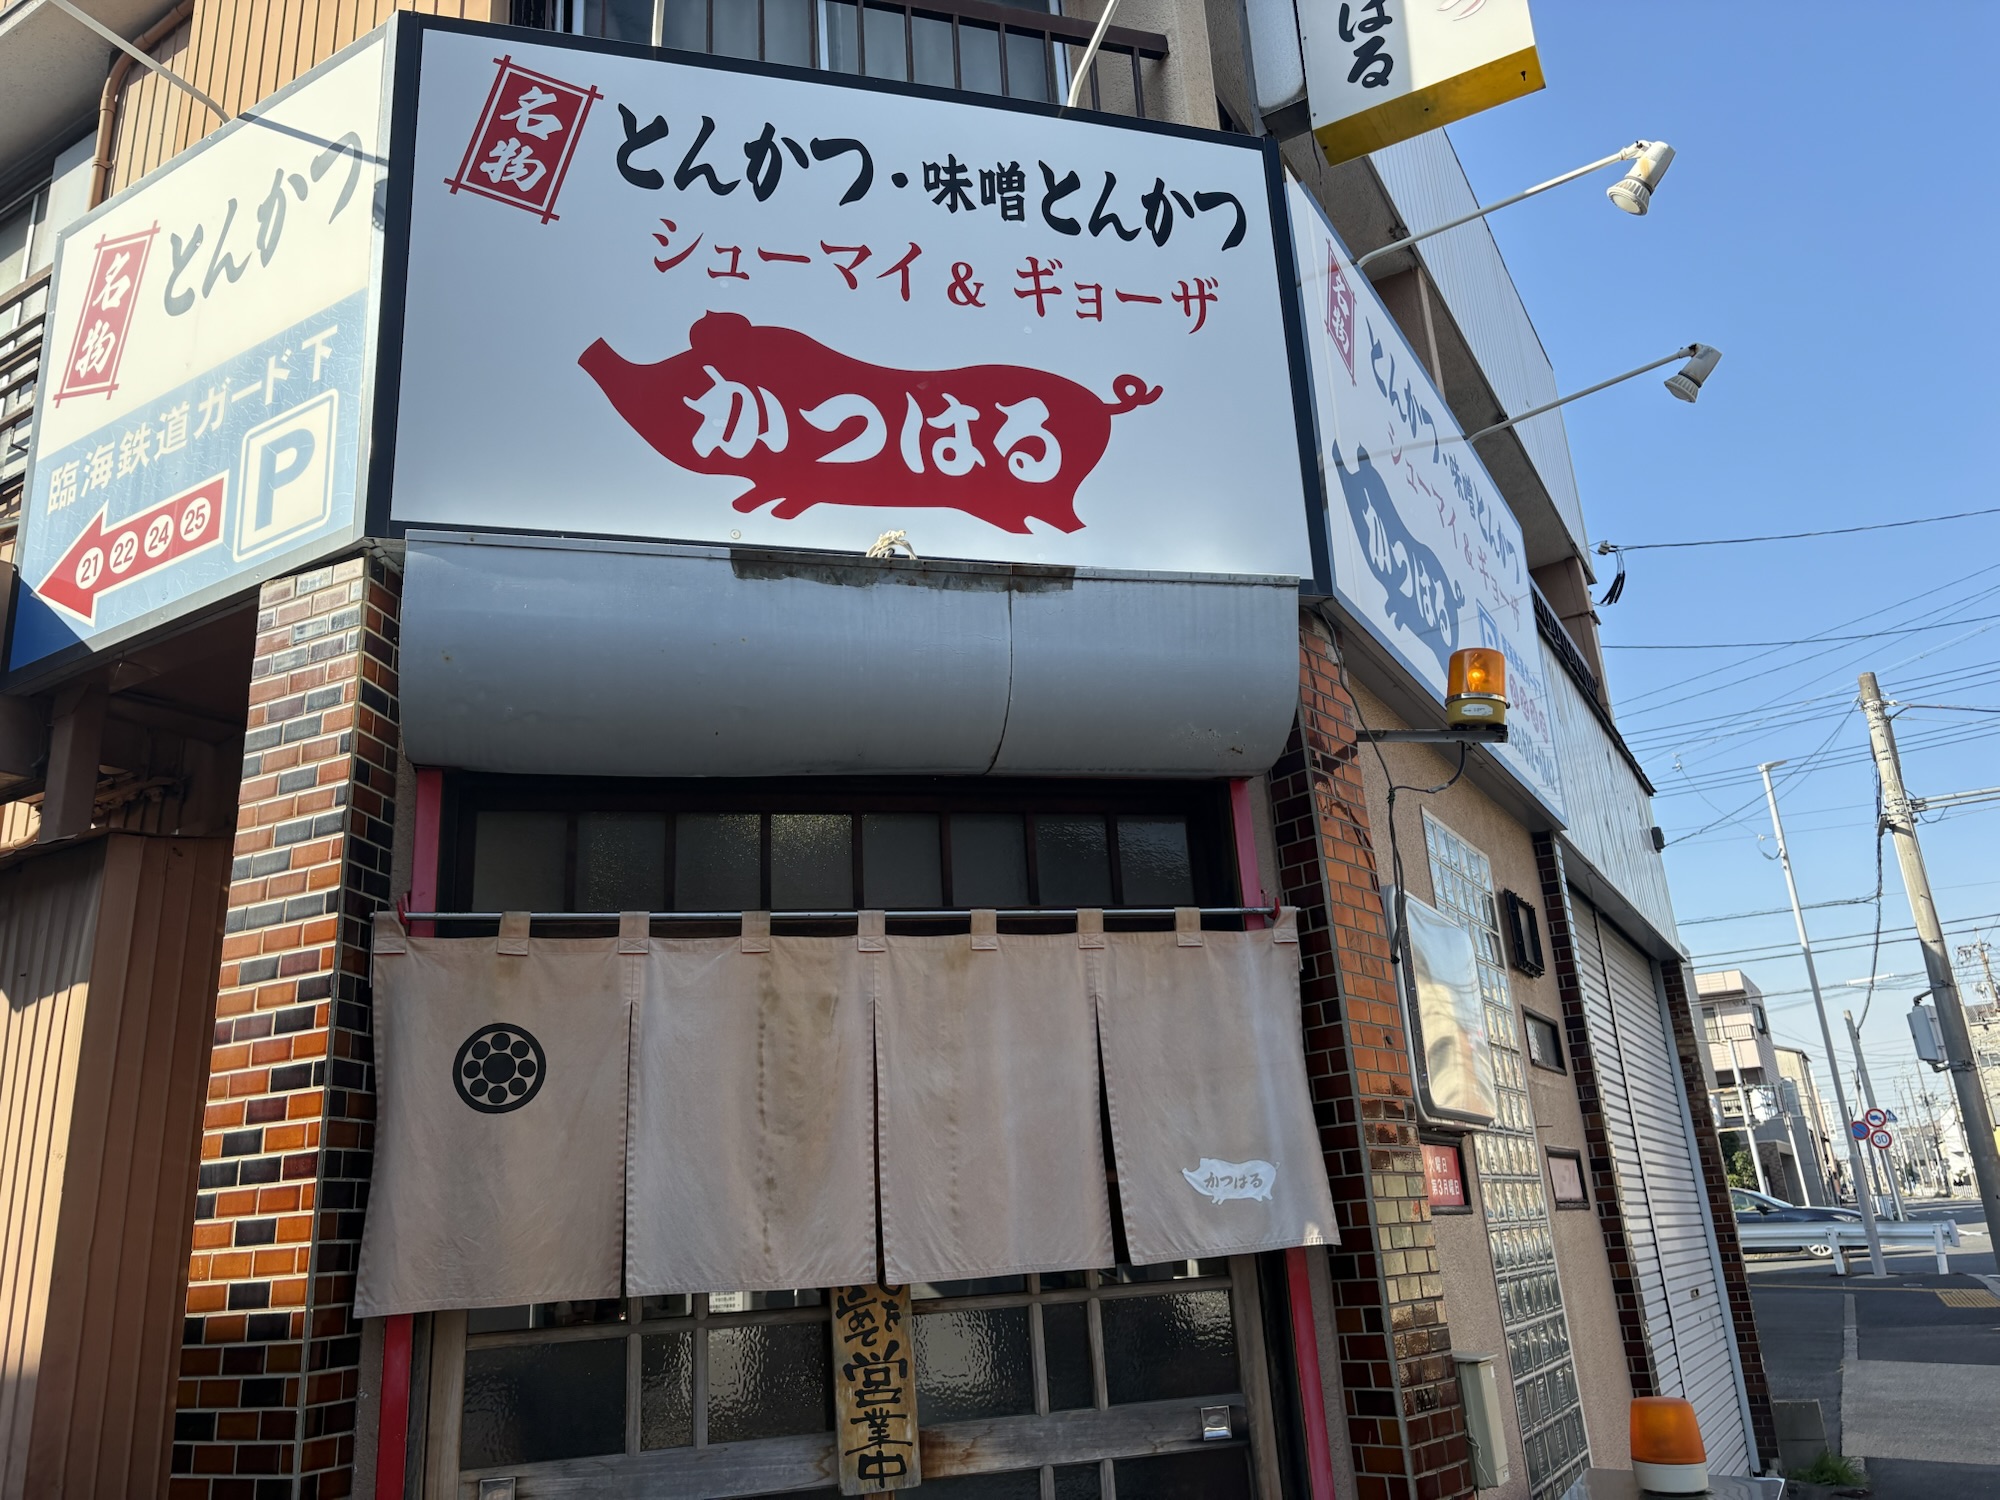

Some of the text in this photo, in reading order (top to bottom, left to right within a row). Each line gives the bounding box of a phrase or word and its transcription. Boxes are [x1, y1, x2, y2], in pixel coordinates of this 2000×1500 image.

[1338, 0, 1394, 88] はる
[478, 84, 566, 193] 名物
[615, 102, 1249, 251] とんかつ・味噌とんかつ
[163, 131, 364, 317] とんかつ
[651, 217, 1220, 334] シューマイ & ギョーザ
[74, 250, 133, 380] 名物
[1331, 273, 1351, 355] 名物
[46, 324, 340, 516] 臨海鉄道ガード下
[683, 364, 1063, 484] かつはる
[253, 427, 316, 533] P
[80, 502, 208, 579] 21 22 24 25
[1361, 487, 1453, 648] かつはる
[1463, 532, 1475, 571] &
[1203, 1171, 1264, 1189] かつはる
[1431, 1179, 1460, 1196] 第3月曜日
[1874, 1134, 1888, 1144] 30
[842, 1340, 914, 1489] 営業中
